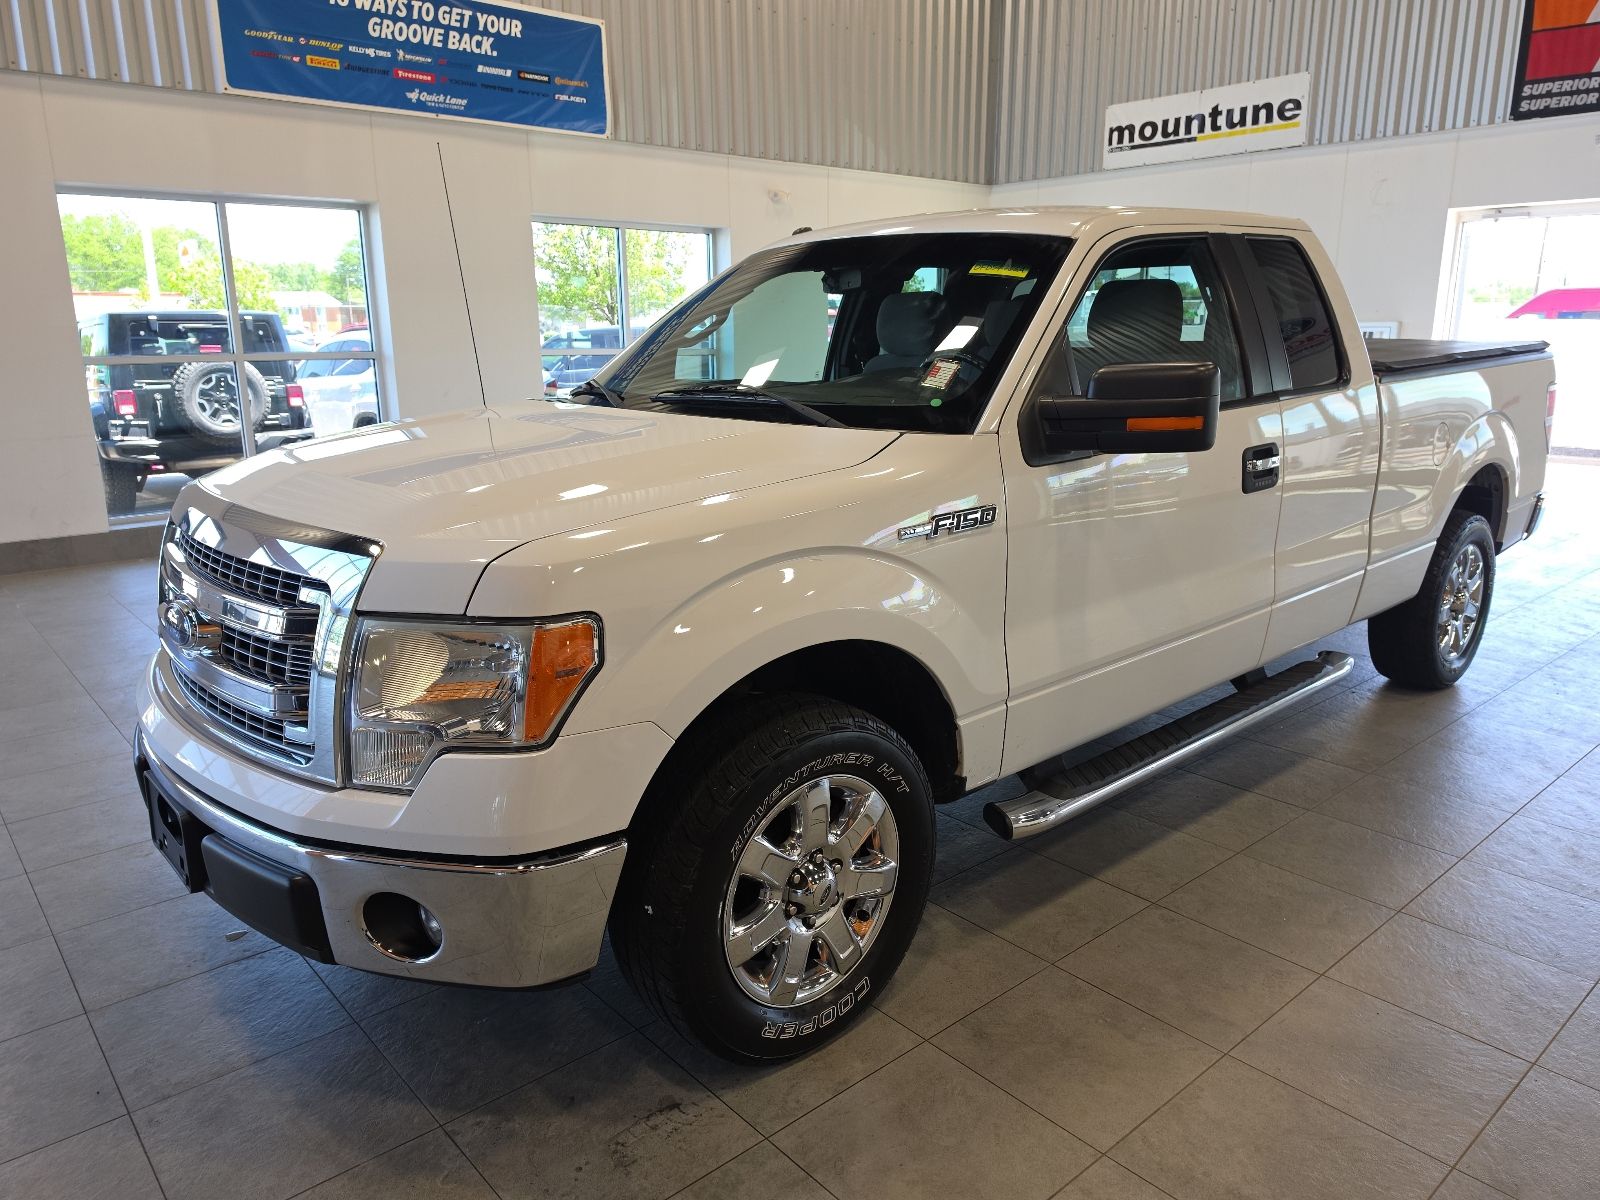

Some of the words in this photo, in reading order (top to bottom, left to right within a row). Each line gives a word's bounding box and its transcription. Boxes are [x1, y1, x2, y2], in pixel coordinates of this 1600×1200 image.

[244, 29, 294, 43] GOODYEAR
[367, 17, 444, 48] GROOVE
[447, 30, 498, 57] BACK.
[411, 1, 435, 22] TO
[438, 5, 472, 29] GET
[476, 12, 522, 38] YOUR
[419, 91, 446, 103] Quick
[445, 95, 468, 106] Lane
[1518, 92, 1599, 112] SUPERIOR
[1521, 76, 1600, 97] SUPERIOR
[1107, 98, 1302, 147] mountune
[931, 504, 997, 538] F-150
[730, 752, 875, 862] ADVENTURER
[877, 763, 910, 794] H/T
[761, 976, 871, 1039] COOPER
